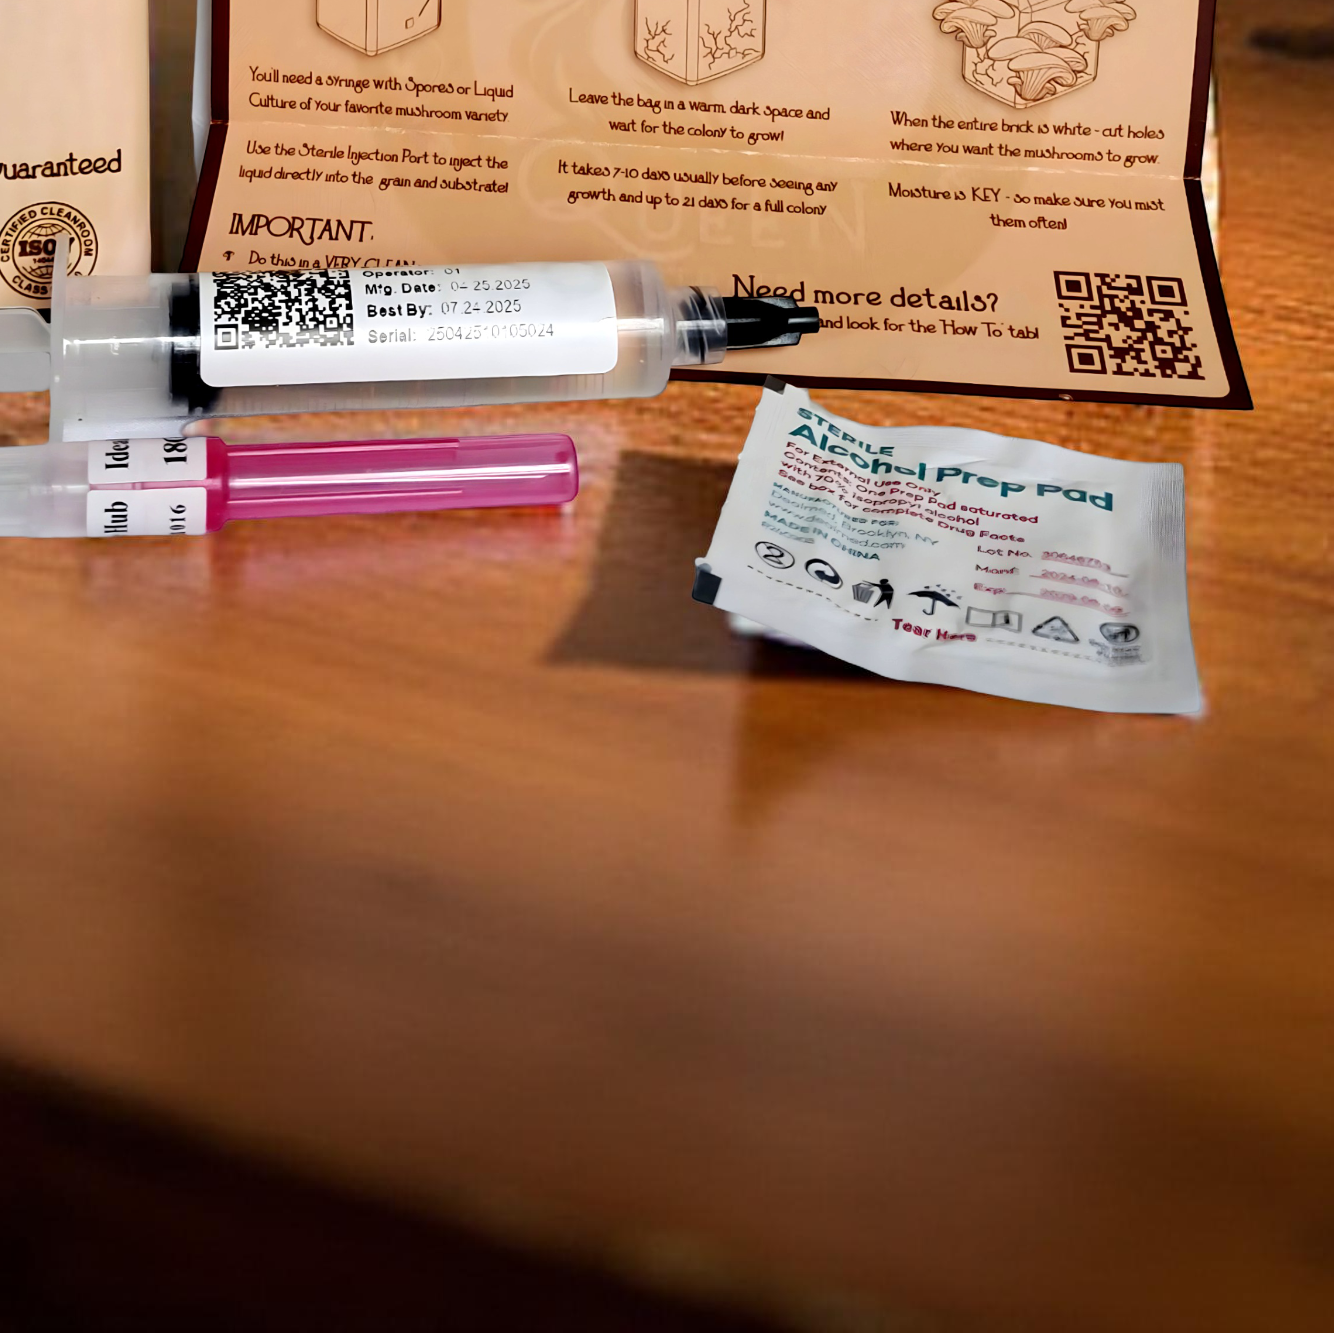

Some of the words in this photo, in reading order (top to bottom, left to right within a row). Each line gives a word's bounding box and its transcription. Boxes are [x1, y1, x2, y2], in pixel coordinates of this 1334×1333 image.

[282, 70, 313, 85] need
[325, 75, 371, 94] syringe
[372, 76, 403, 91] with
[404, 76, 455, 98] Spores
[456, 86, 472, 96] or
[473, 80, 514, 103] Liquid
[248, 91, 297, 110] Culture
[299, 96, 313, 111] of
[314, 99, 342, 113] your
[344, 99, 393, 116] favorite
[395, 103, 463, 121] mushroom
[569, 87, 609, 105] Leave
[610, 91, 635, 107] the
[636, 93, 662, 115] bag
[688, 100, 727, 114] warm
[729, 100, 762, 116] dark
[762, 105, 804, 123] space
[805, 107, 831, 121] and
[608, 118, 638, 133] wait
[640, 119, 660, 134] for
[661, 120, 686, 136] the
[686, 123, 728, 139] colony
[728, 125, 745, 140] to
[889, 110, 929, 128] When
[930, 114, 955, 130] the
[957, 116, 999, 132] entire
[1001, 118, 1035, 134] brick
[1052, 121, 1092, 137] white
[1101, 123, 1124, 138] cut
[1127, 124, 1165, 140] holes
[246, 139, 272, 156] Use
[273, 142, 296, 157] the
[297, 142, 345, 159] Sterile
[346, 144, 399, 166] Injection
[401, 148, 430, 165] Port
[432, 151, 447, 166] to
[448, 154, 483, 173] inject
[485, 155, 509, 170] the
[889, 138, 933, 153] where
[935, 142, 960, 154] you
[961, 142, 995, 156] want
[996, 143, 1022, 158] the
[1023, 145, 1104, 162] mushrooms
[1105, 148, 1122, 163] to
[238, 164, 274, 184] liquid
[273, 166, 324, 182] directly
[324, 169, 349, 184] into
[350, 170, 374, 185] the
[378, 176, 412, 192] grain
[413, 175, 438, 189] and
[570, 161, 611, 177] takes
[612, 166, 640, 179] 7-10
[641, 166, 671, 182] days
[673, 170, 720, 185] usually
[722, 172, 767, 188] before
[769, 177, 815, 197] seeing
[815, 181, 839, 192] any
[566, 187, 617, 205] growth
[618, 190, 643, 204] and
[645, 194, 663, 210] up
[663, 192, 680, 207] to
[681, 196, 696, 208] 21
[697, 195, 729, 210] days
[730, 197, 751, 211] for
[764, 198, 785, 213] full
[785, 200, 828, 216] colony
[888, 181, 952, 200] Moisture
[971, 186, 1002, 203] KEY
[1013, 193, 1032, 205] so
[1033, 192, 1072, 207] make
[1072, 196, 1106, 208] sure
[1107, 197, 1133, 210] you
[1134, 198, 1166, 212] mist
[0, 209, 38, 263] CERTIFIED
[40, 206, 94, 257] CLEANROOM
[988, 213, 1027, 229] them
[248, 250, 267, 265] Do
[270, 253, 296, 267] this
[12, 275, 48, 295] CLASS
[732, 273, 805, 303] Need
[813, 289, 883, 307] more
[889, 286, 999, 313] details?
[366, 304, 403, 318] Best
[406, 303, 433, 318] By:
[818, 316, 844, 329] and
[846, 315, 881, 331] look
[883, 317, 906, 332] for
[907, 318, 938, 334] the
[368, 328, 417, 344] Serial:
[796, 407, 895, 457] STERILE
[785, 441, 810, 456] For
[788, 423, 927, 481] Alcohol
[936, 467, 1026, 498] Prep
[1036, 483, 1113, 512] Pad
[780, 460, 812, 480] with
[924, 507, 980, 526] alcohol
[855, 484, 886, 497] One
[889, 488, 924, 502] Prep
[928, 497, 957, 511] Pad
[960, 504, 1039, 524] saturated
[104, 501, 128, 534] Hub
[891, 618, 933, 638] Tear
